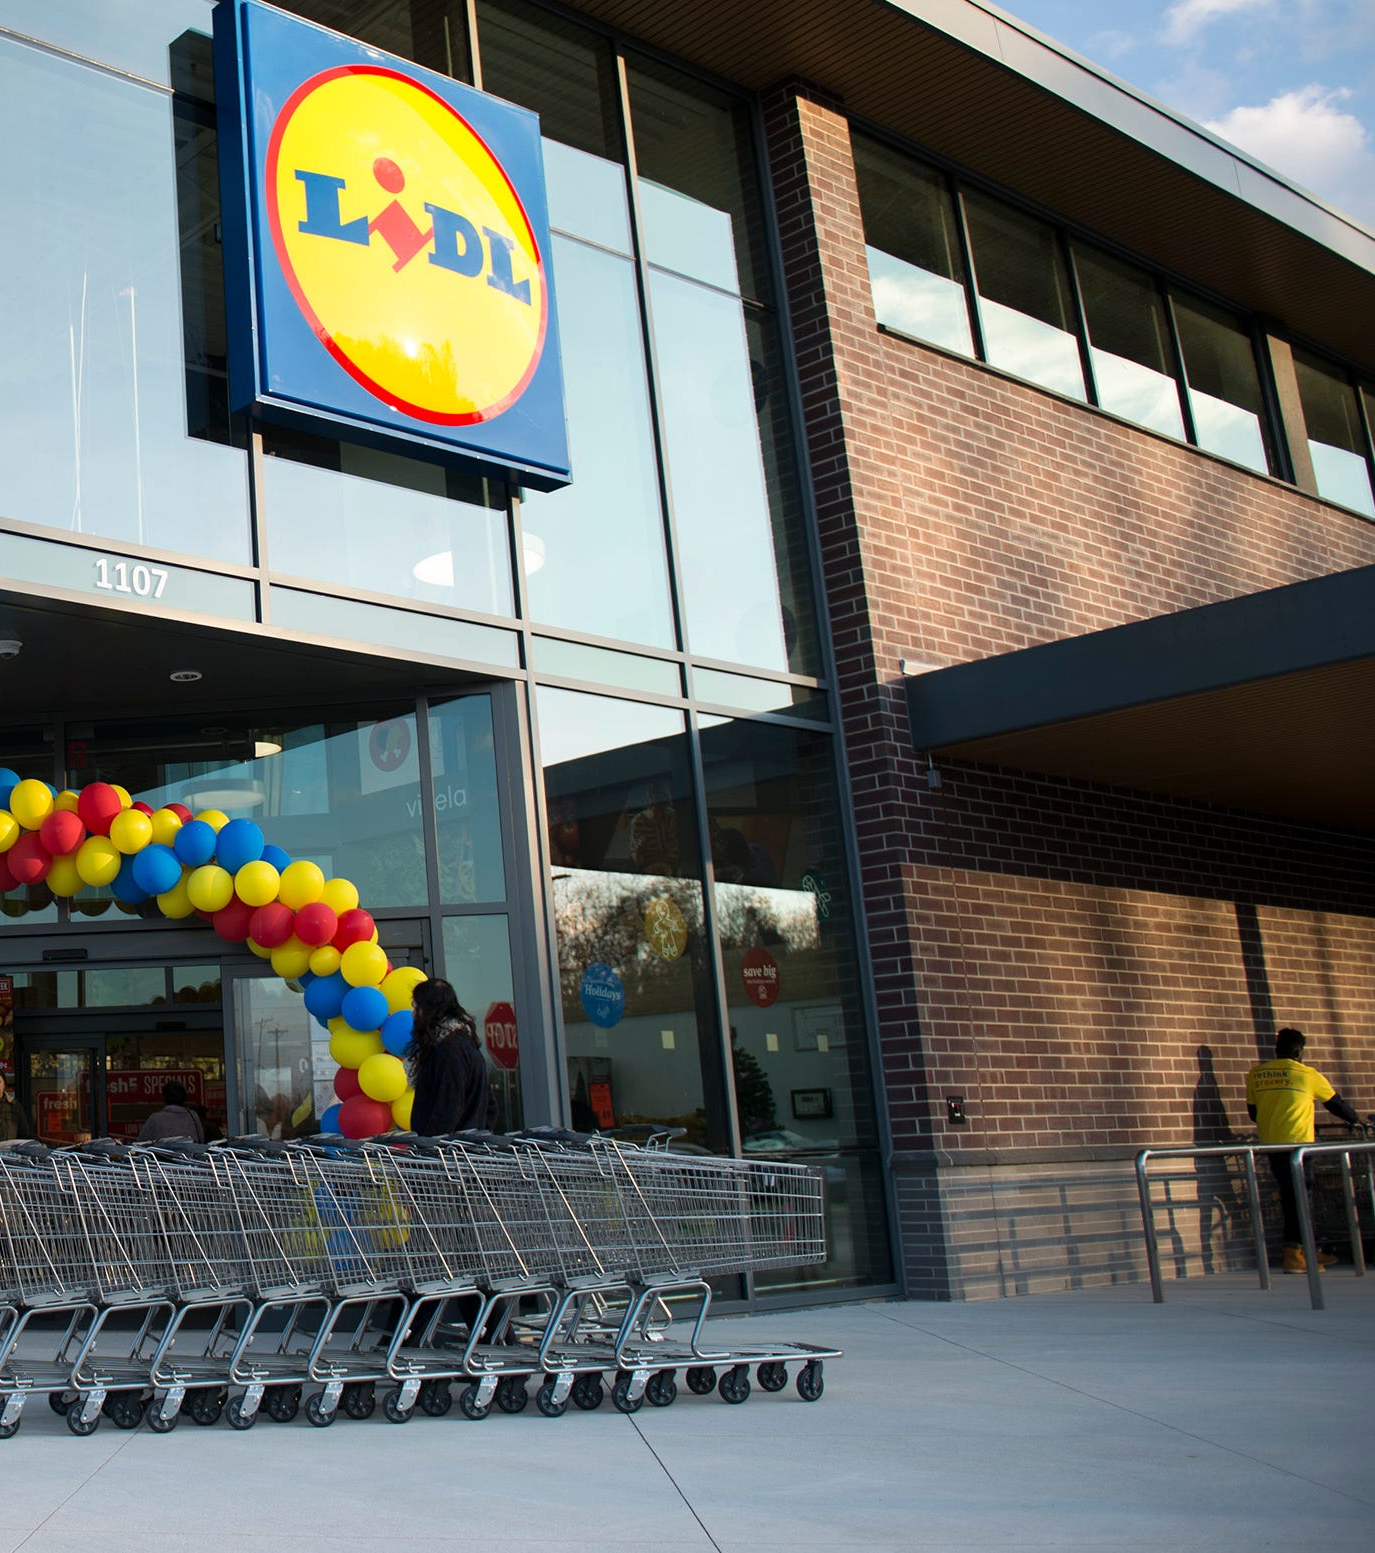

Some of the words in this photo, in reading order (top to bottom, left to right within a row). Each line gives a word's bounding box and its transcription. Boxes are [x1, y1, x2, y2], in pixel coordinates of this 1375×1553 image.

[95, 558, 168, 599] 1107
[406, 785, 467, 817] viela
[743, 967, 762, 978] save
[762, 964, 777, 979] big
[585, 983, 622, 1001] Holidays
[1254, 1070, 1288, 1078] rethink
[43, 1096, 77, 1110] fresh
